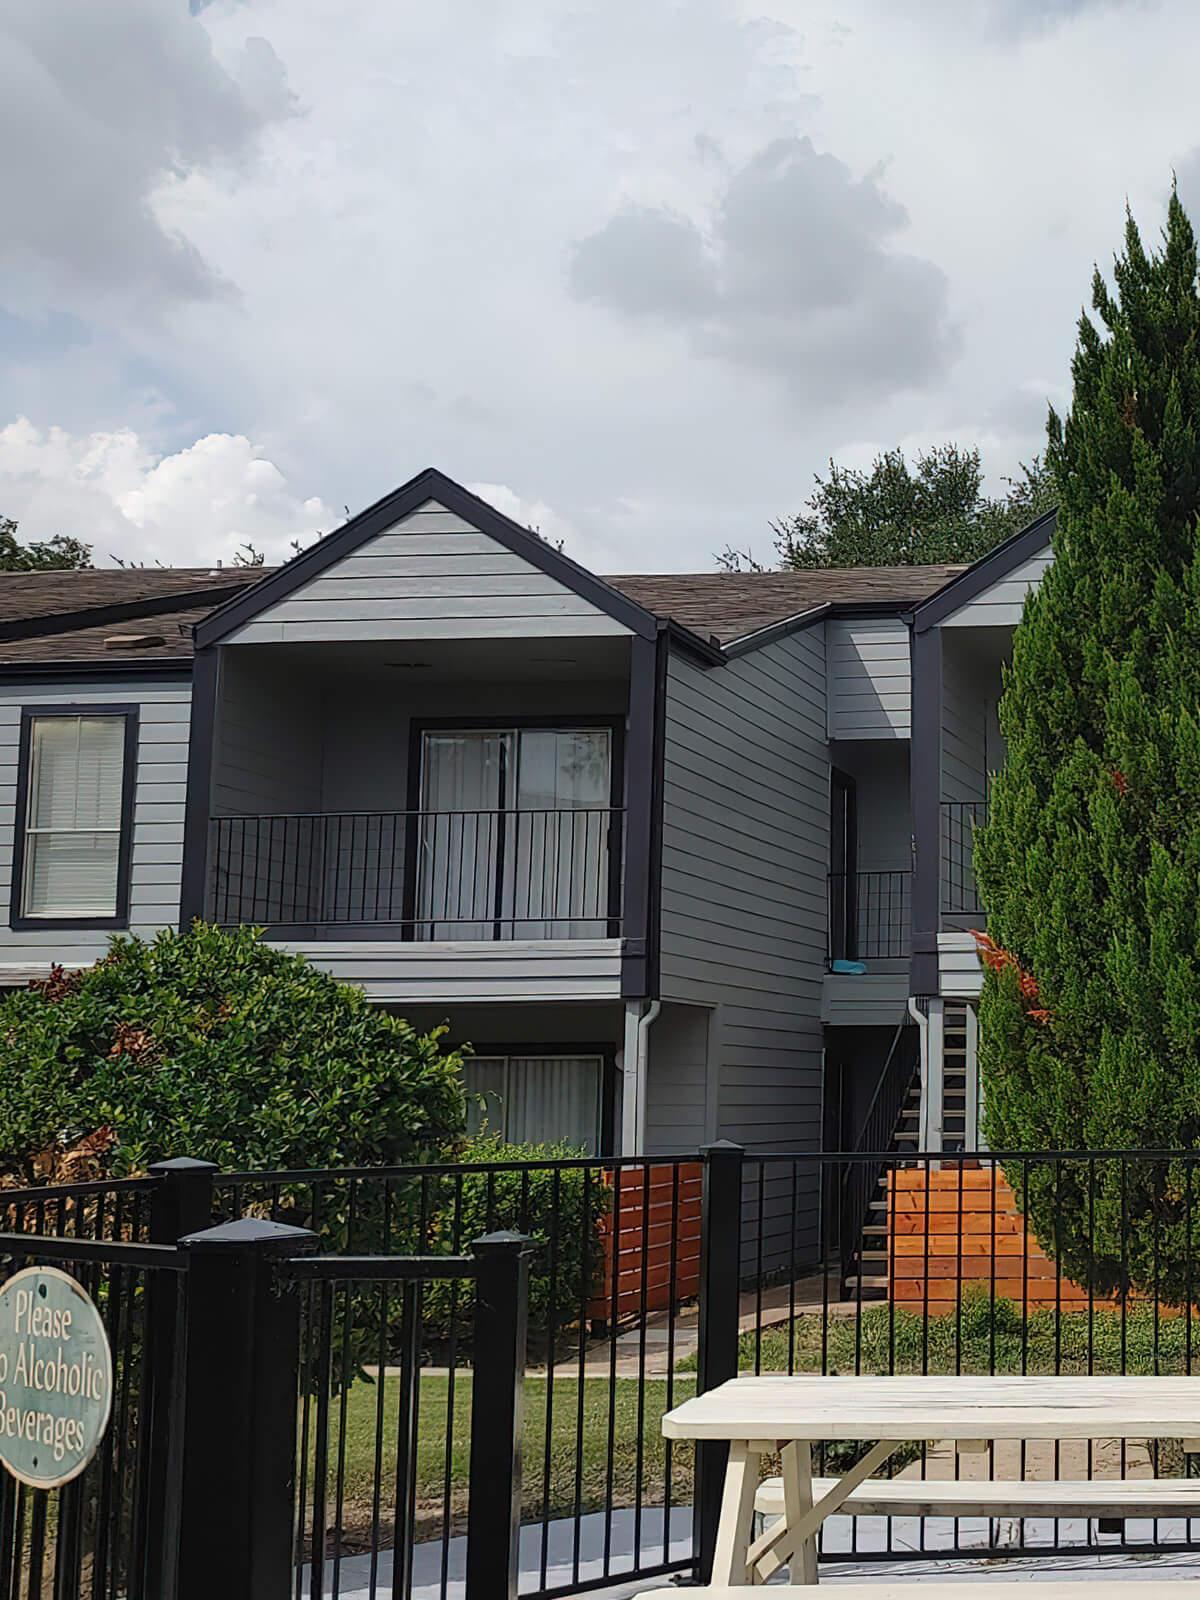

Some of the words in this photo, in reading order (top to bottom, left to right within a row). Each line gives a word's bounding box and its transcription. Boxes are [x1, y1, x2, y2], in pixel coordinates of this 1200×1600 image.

[15, 1289, 72, 1341] Please
[0, 1352, 8, 1383] o
[13, 1342, 103, 1400] Alcoholic
